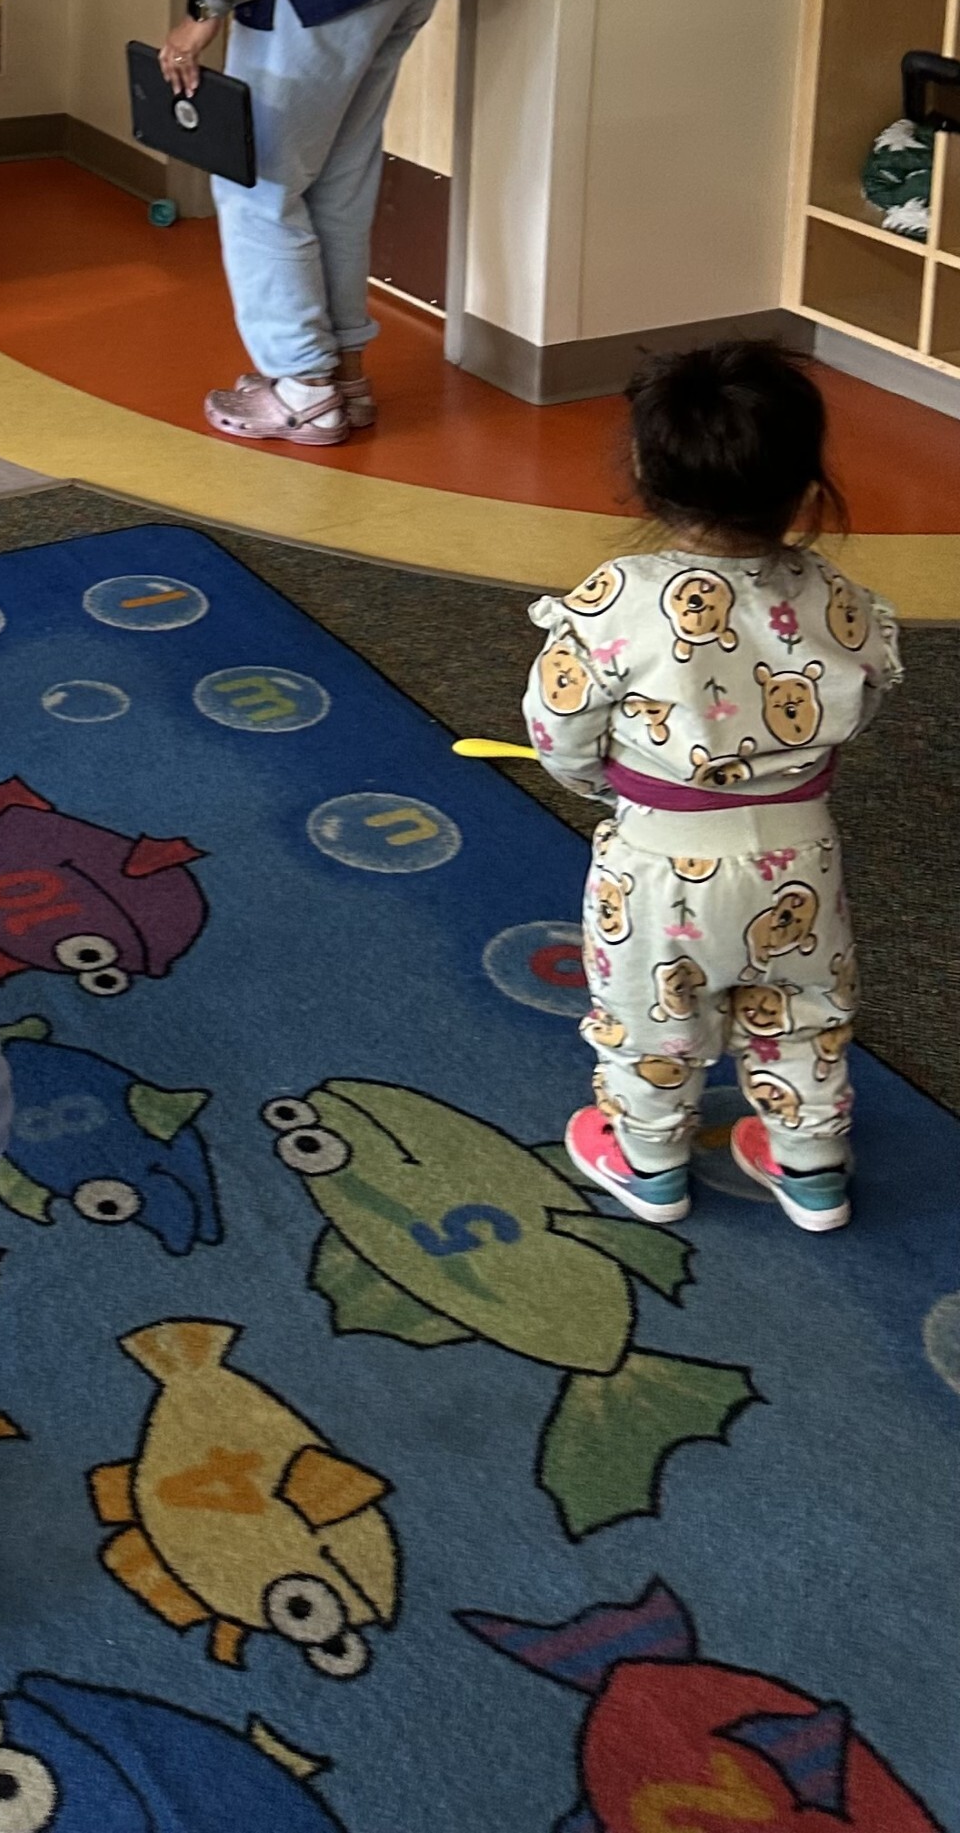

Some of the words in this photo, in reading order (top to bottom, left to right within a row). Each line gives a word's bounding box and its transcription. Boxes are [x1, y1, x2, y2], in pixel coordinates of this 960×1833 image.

[215, 675, 297, 722] m
[365, 807, 439, 847] n
[409, 1203, 522, 1257] 5
[155, 1445, 266, 1516] 4
